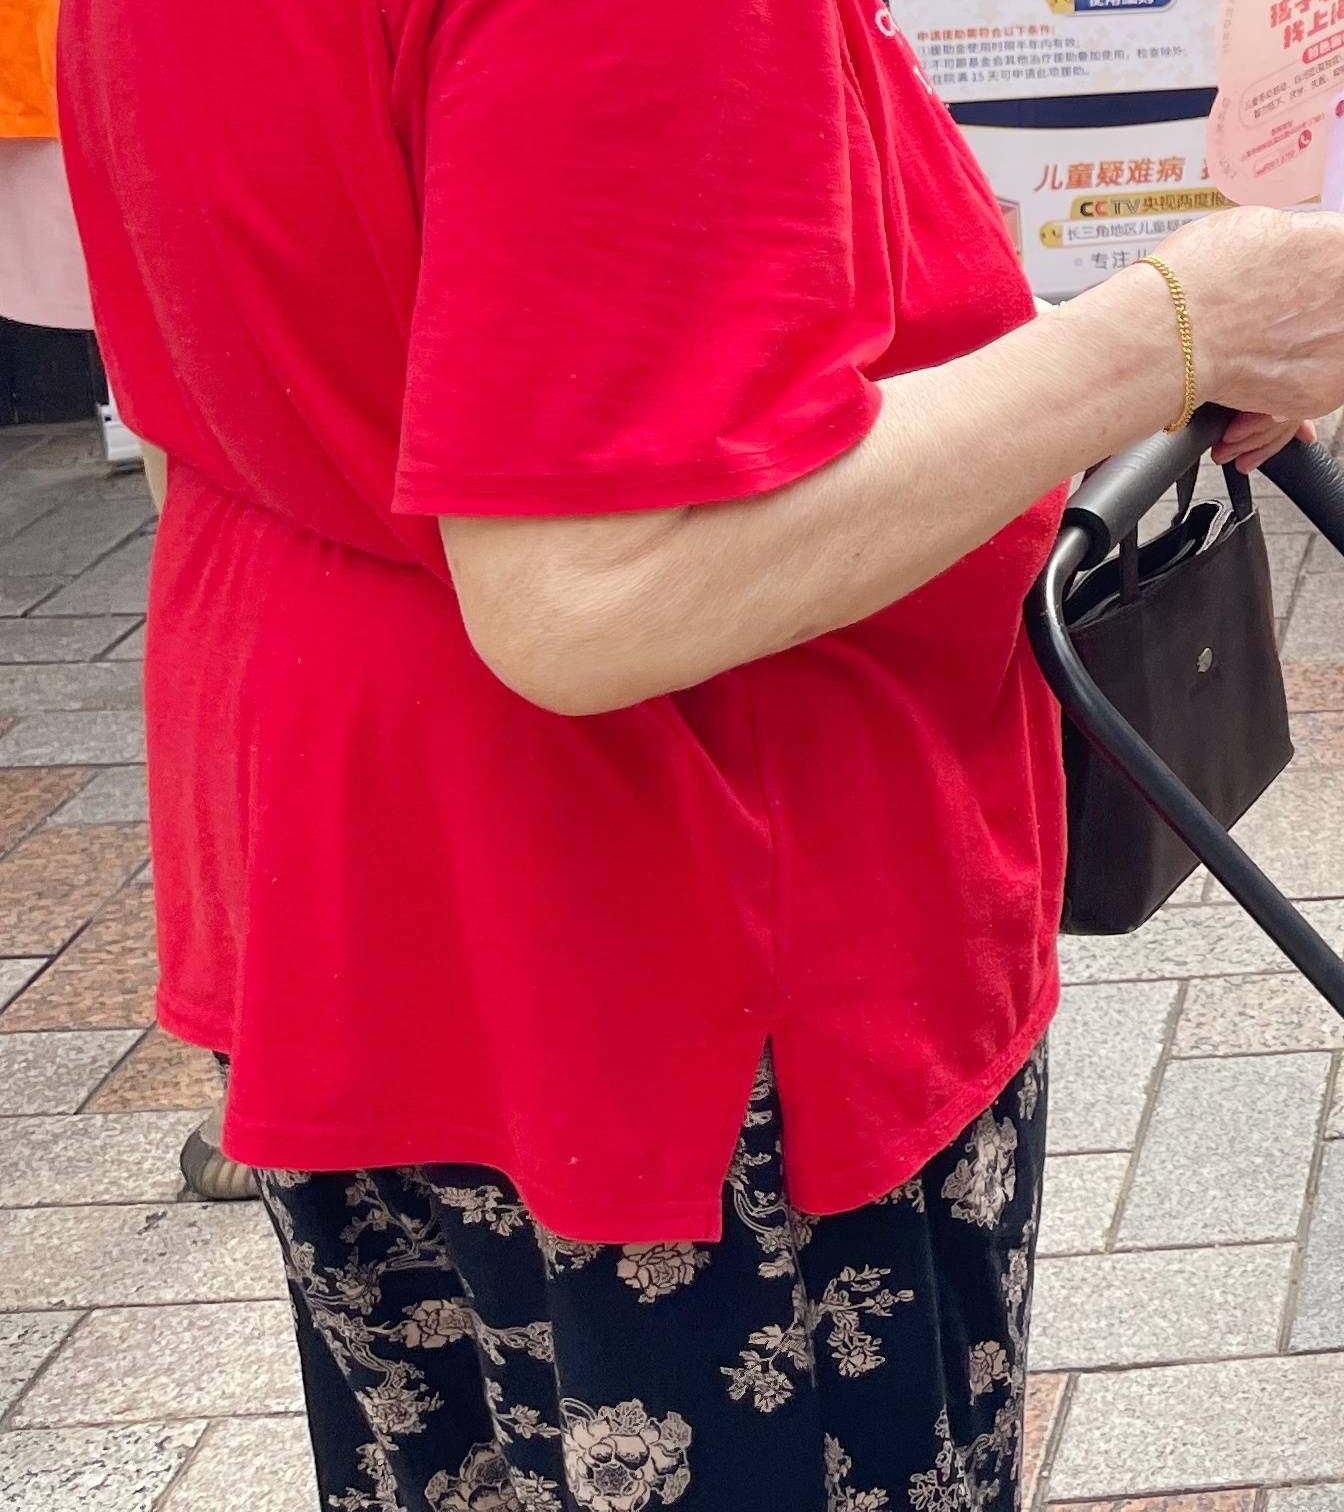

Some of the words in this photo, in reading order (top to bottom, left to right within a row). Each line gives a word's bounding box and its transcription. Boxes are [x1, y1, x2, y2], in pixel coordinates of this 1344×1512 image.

[1034, 156, 1185, 192] 儿童疑难病
[1068, 219, 1190, 241] 长三角地区儿童疑
